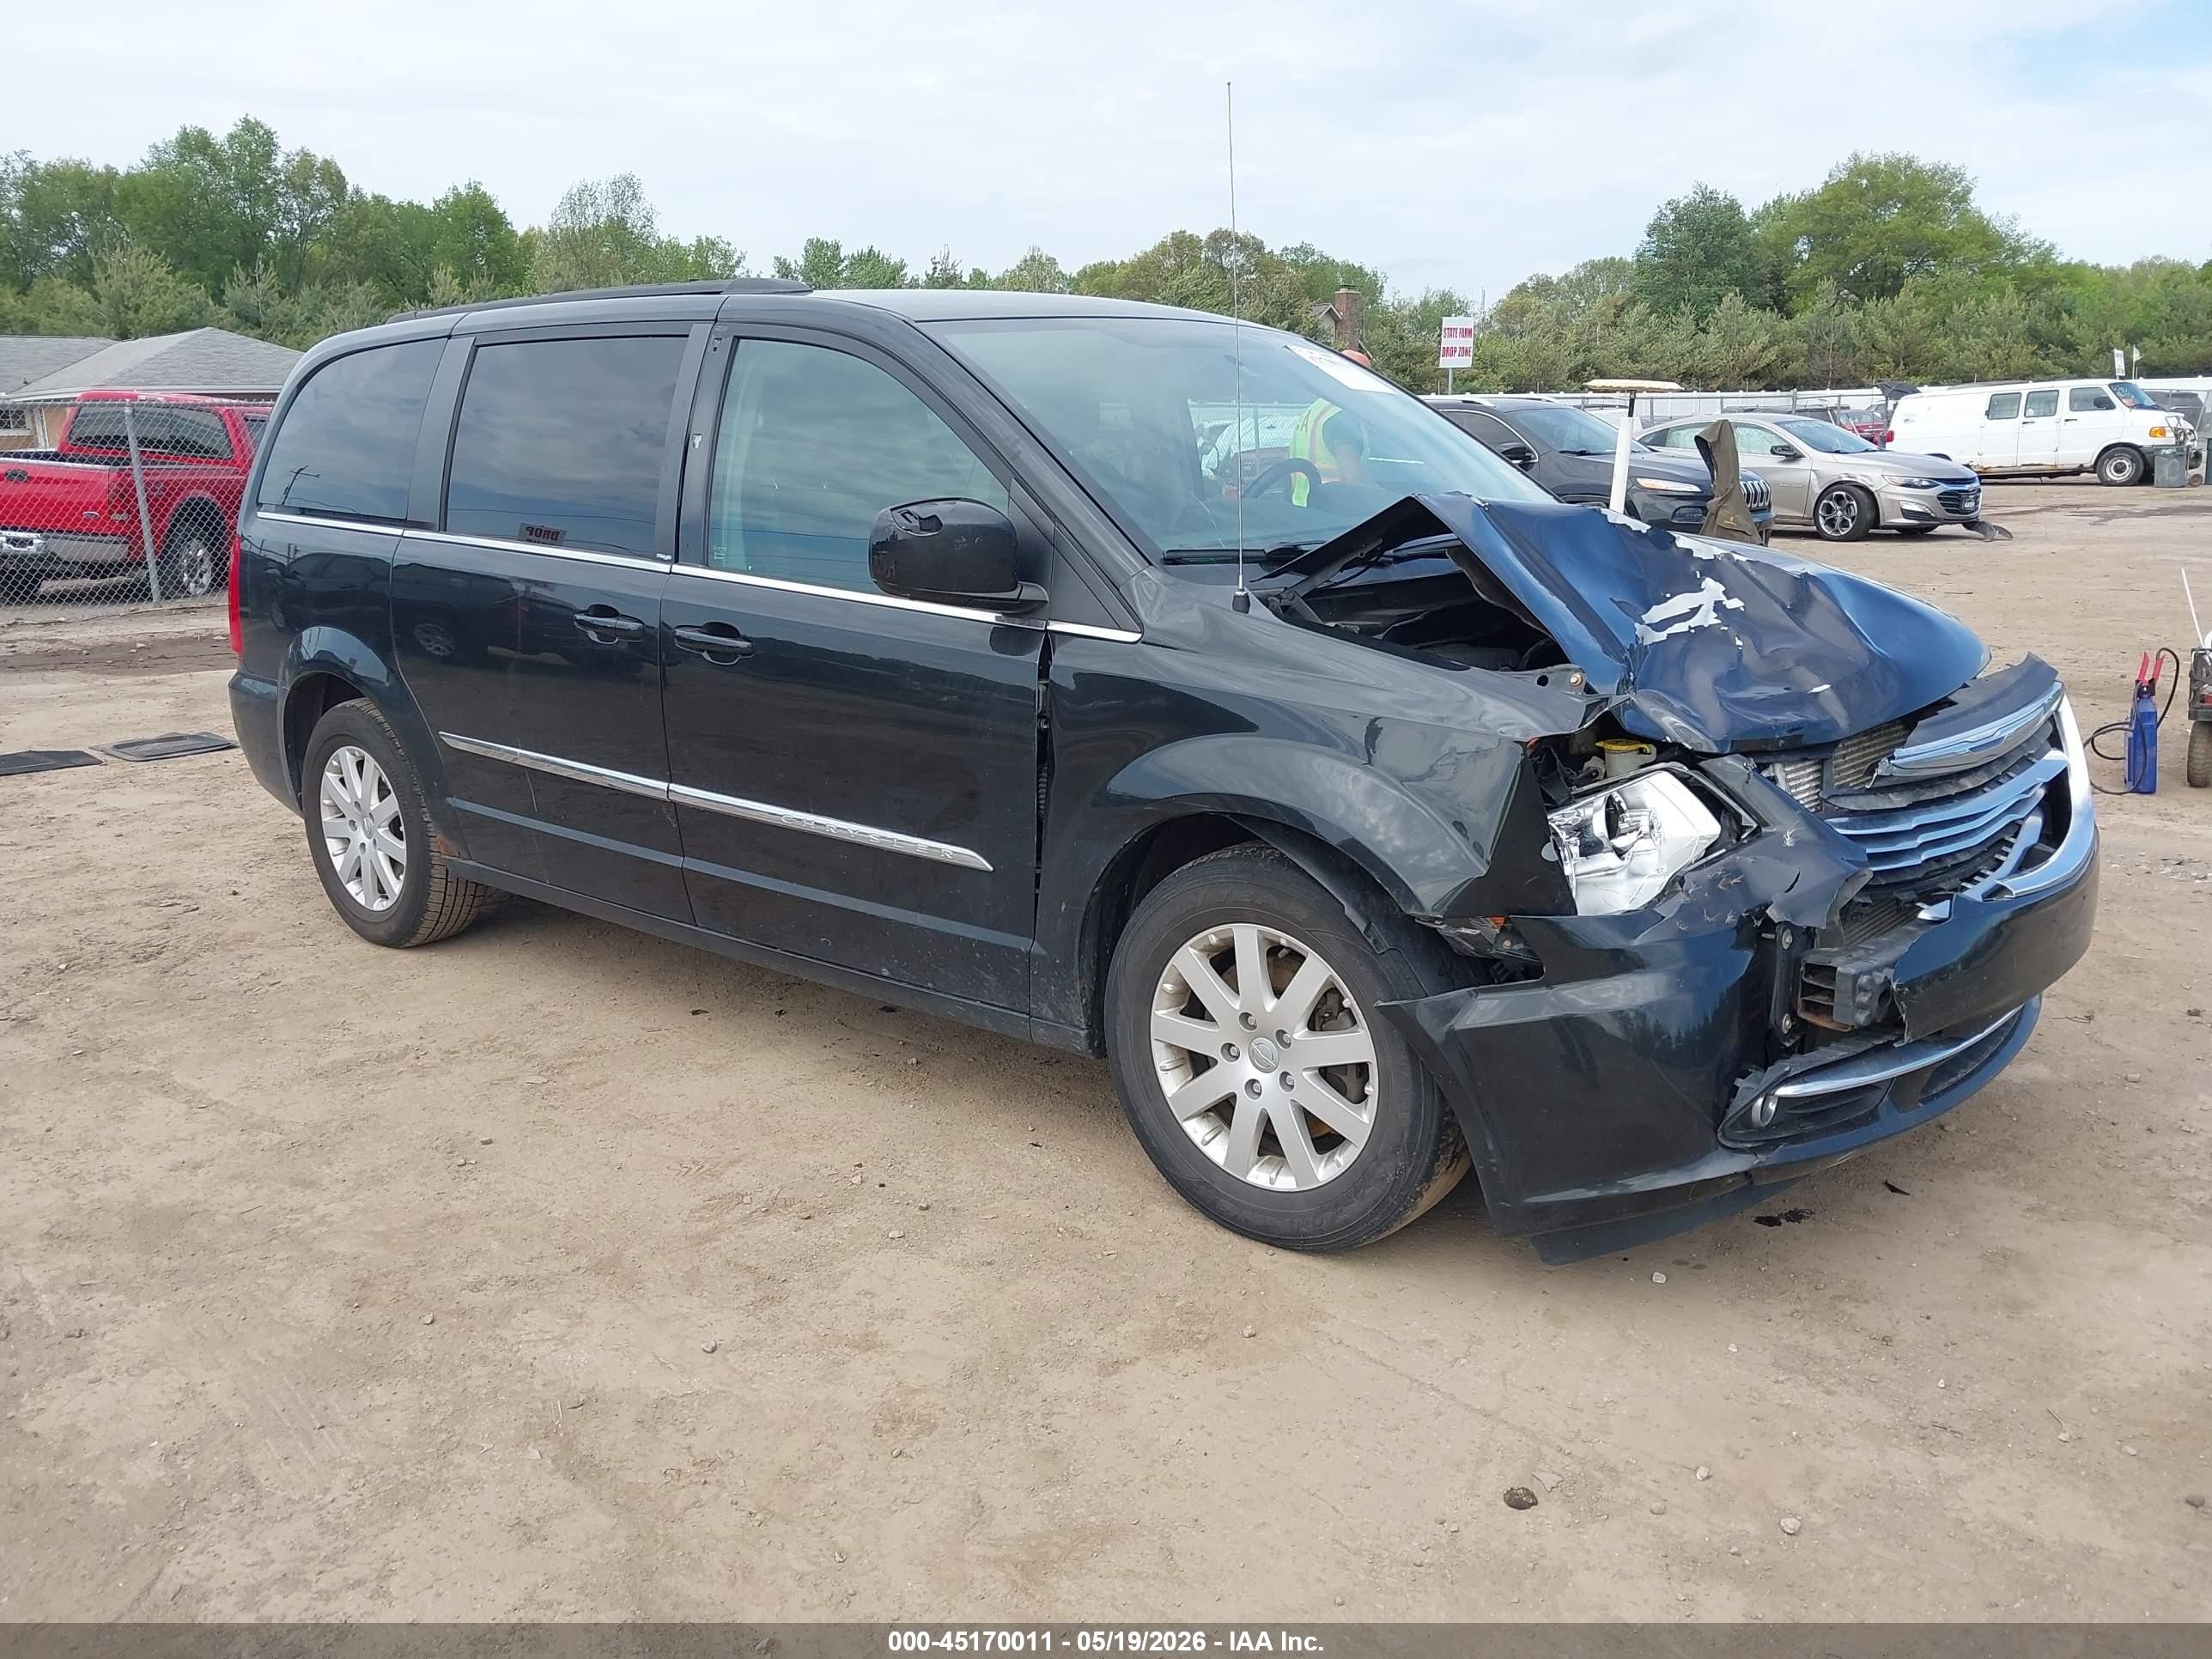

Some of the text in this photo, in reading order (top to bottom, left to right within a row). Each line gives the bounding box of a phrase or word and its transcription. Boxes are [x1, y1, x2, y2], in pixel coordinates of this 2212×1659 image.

[1443, 327, 1473, 338] STATE FARM
[1442, 346, 1471, 357] DROP ZONE
